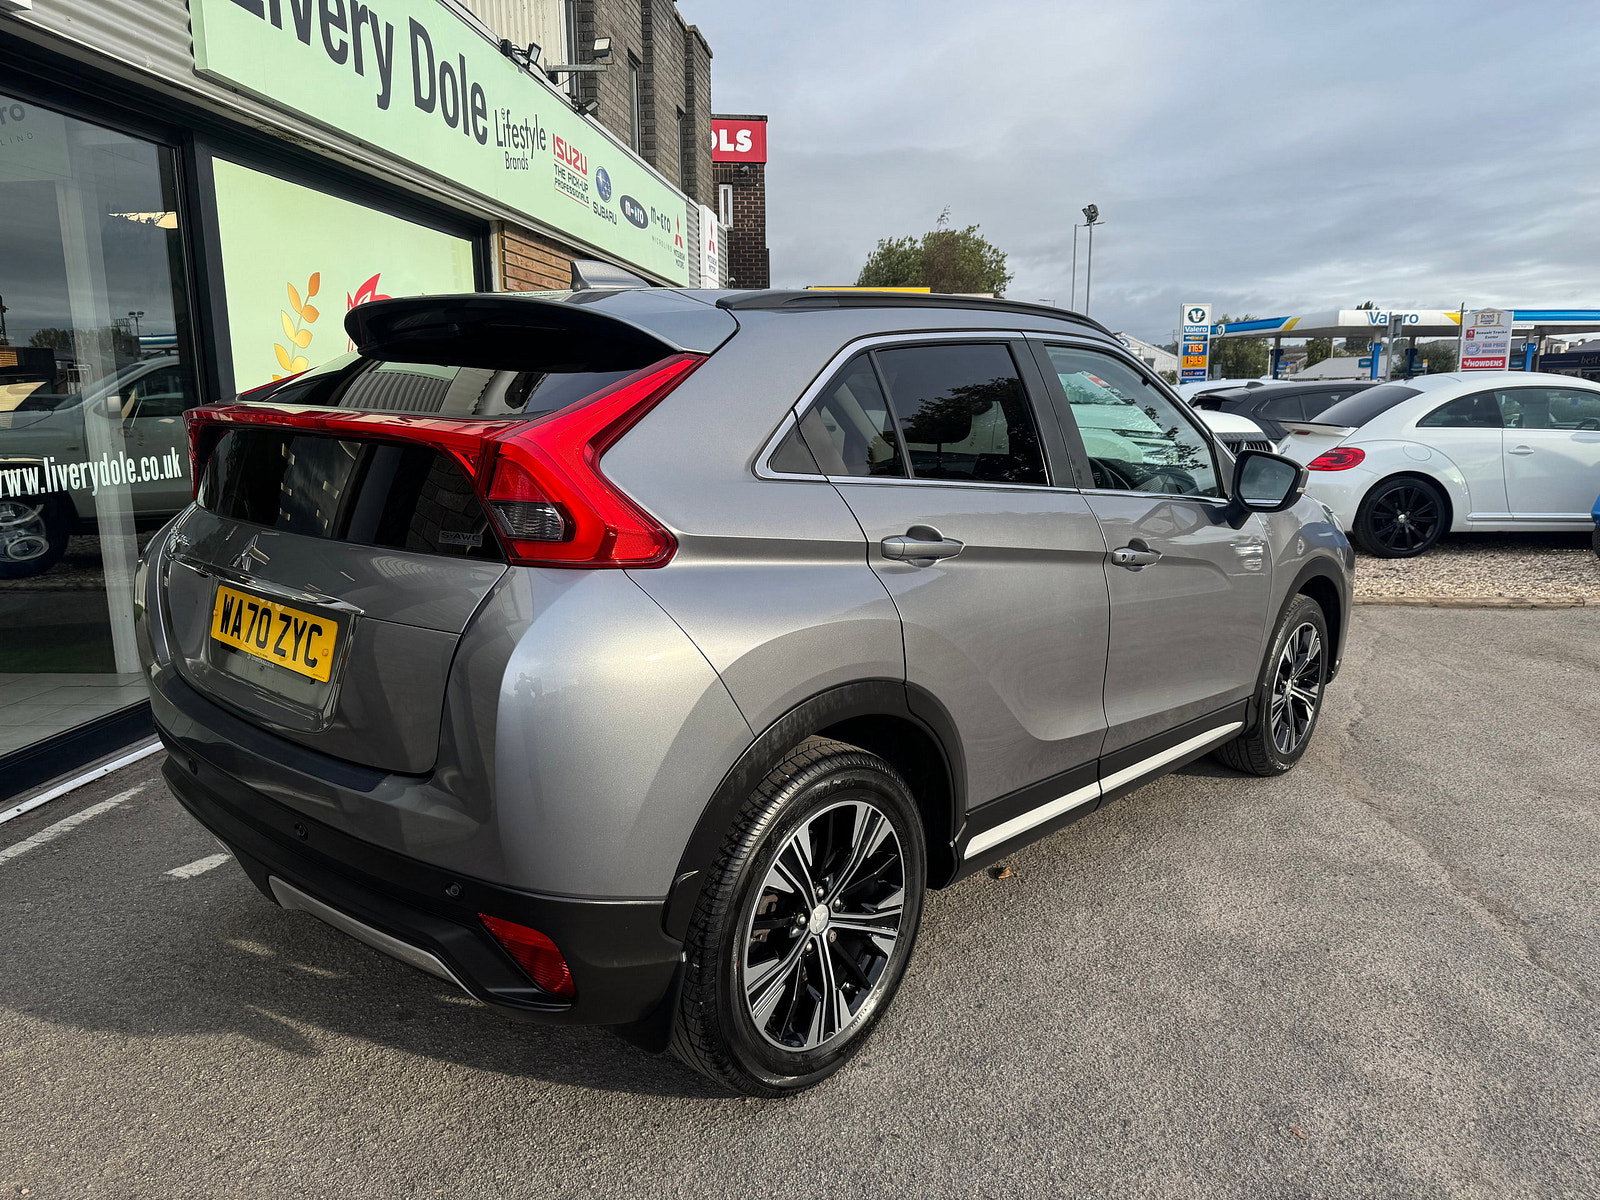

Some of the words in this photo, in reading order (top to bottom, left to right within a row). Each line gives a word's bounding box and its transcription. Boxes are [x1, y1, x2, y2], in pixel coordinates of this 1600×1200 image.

[409, 16, 487, 145] Dole
[494, 108, 547, 160] Lifestyle
[711, 129, 753, 152] LS
[505, 151, 529, 171] Brands
[552, 133, 588, 175] ISUZU
[554, 164, 566, 180] THE
[567, 171, 589, 193] PICK-UP
[554, 178, 590, 205] PROFESSIONALS
[592, 201, 618, 226] SUBARU
[1470, 360, 1503, 368] HOWDENS
[0, 447, 183, 499] ww.liverydole.co.uk
[220, 593, 272, 650] WA70
[273, 613, 323, 669] ZYC
